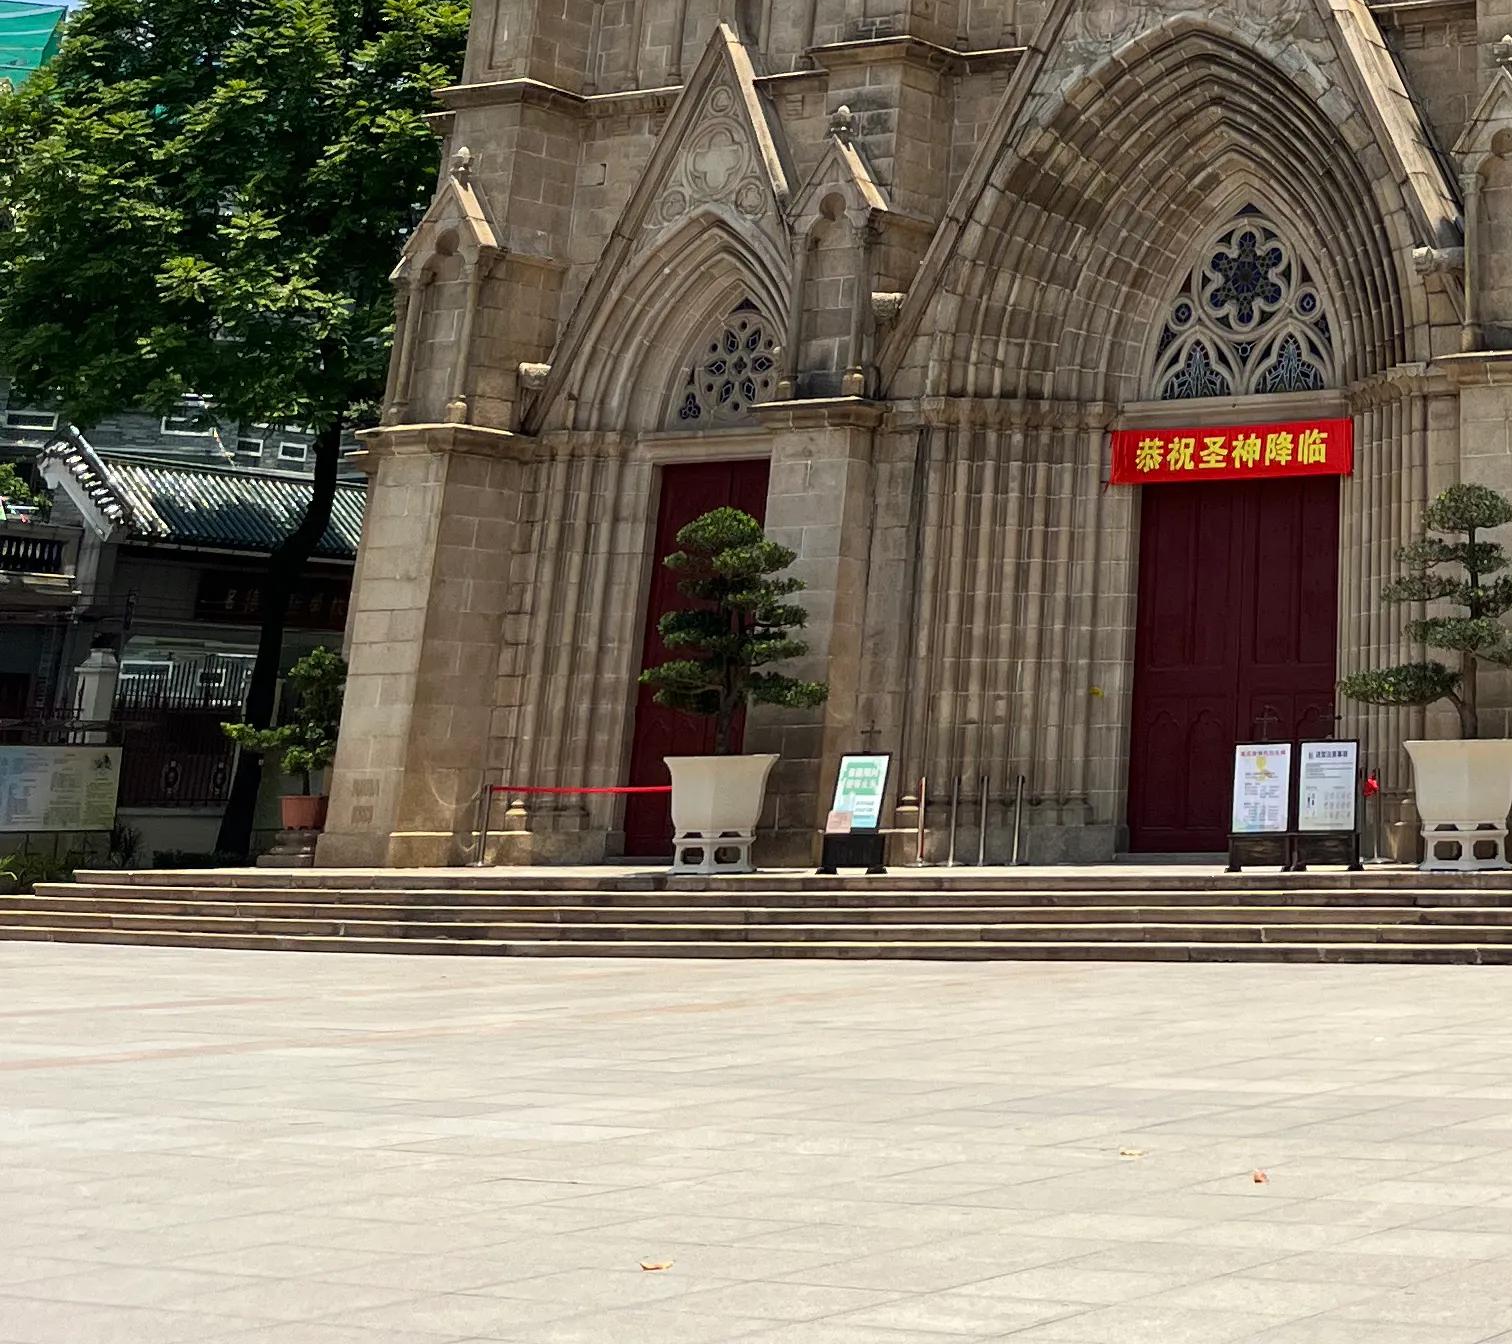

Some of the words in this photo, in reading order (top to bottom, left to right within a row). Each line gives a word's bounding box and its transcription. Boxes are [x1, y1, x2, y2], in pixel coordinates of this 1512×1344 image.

[1135, 428, 1329, 473] 恭祝圣神降临
